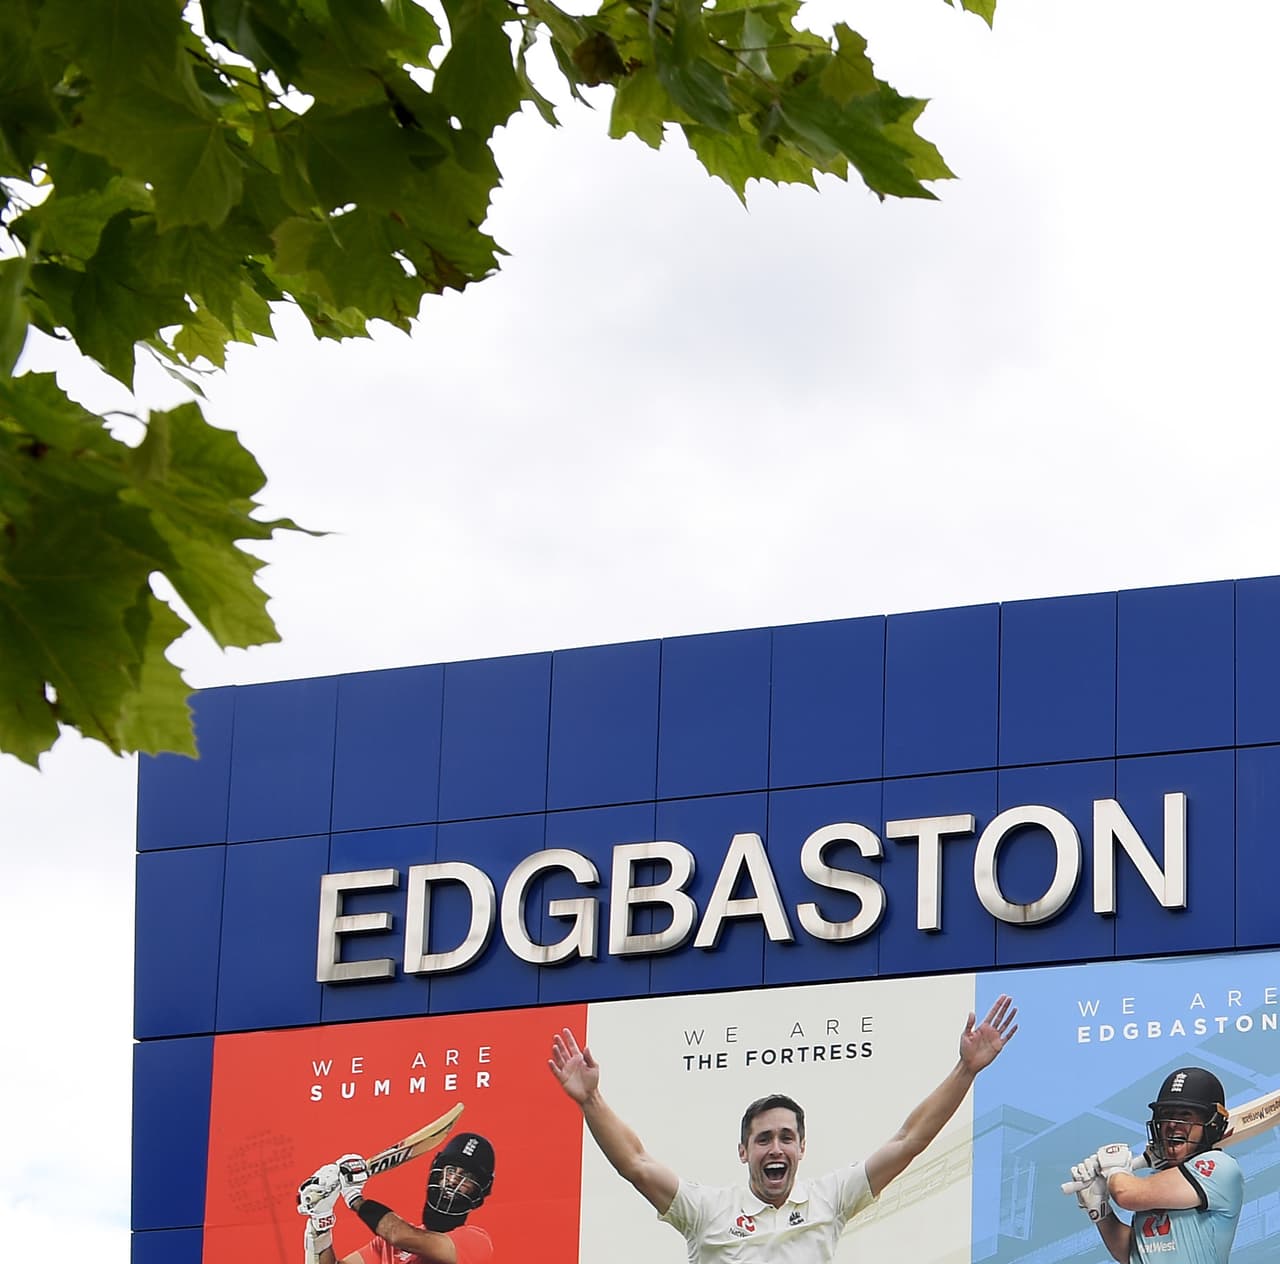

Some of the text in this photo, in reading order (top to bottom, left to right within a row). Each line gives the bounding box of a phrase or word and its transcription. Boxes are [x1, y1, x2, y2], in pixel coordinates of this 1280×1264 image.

[316, 792, 1187, 983] EDGBASTON
[1078, 987, 1278, 1017] WE ARE
[684, 1017, 873, 1046] WE ARE
[1078, 1013, 1277, 1044] EDGBASTON
[312, 1046, 492, 1077] WE ARE
[683, 1042, 873, 1071] THE FORTRESS
[310, 1071, 491, 1102] SUMMER
